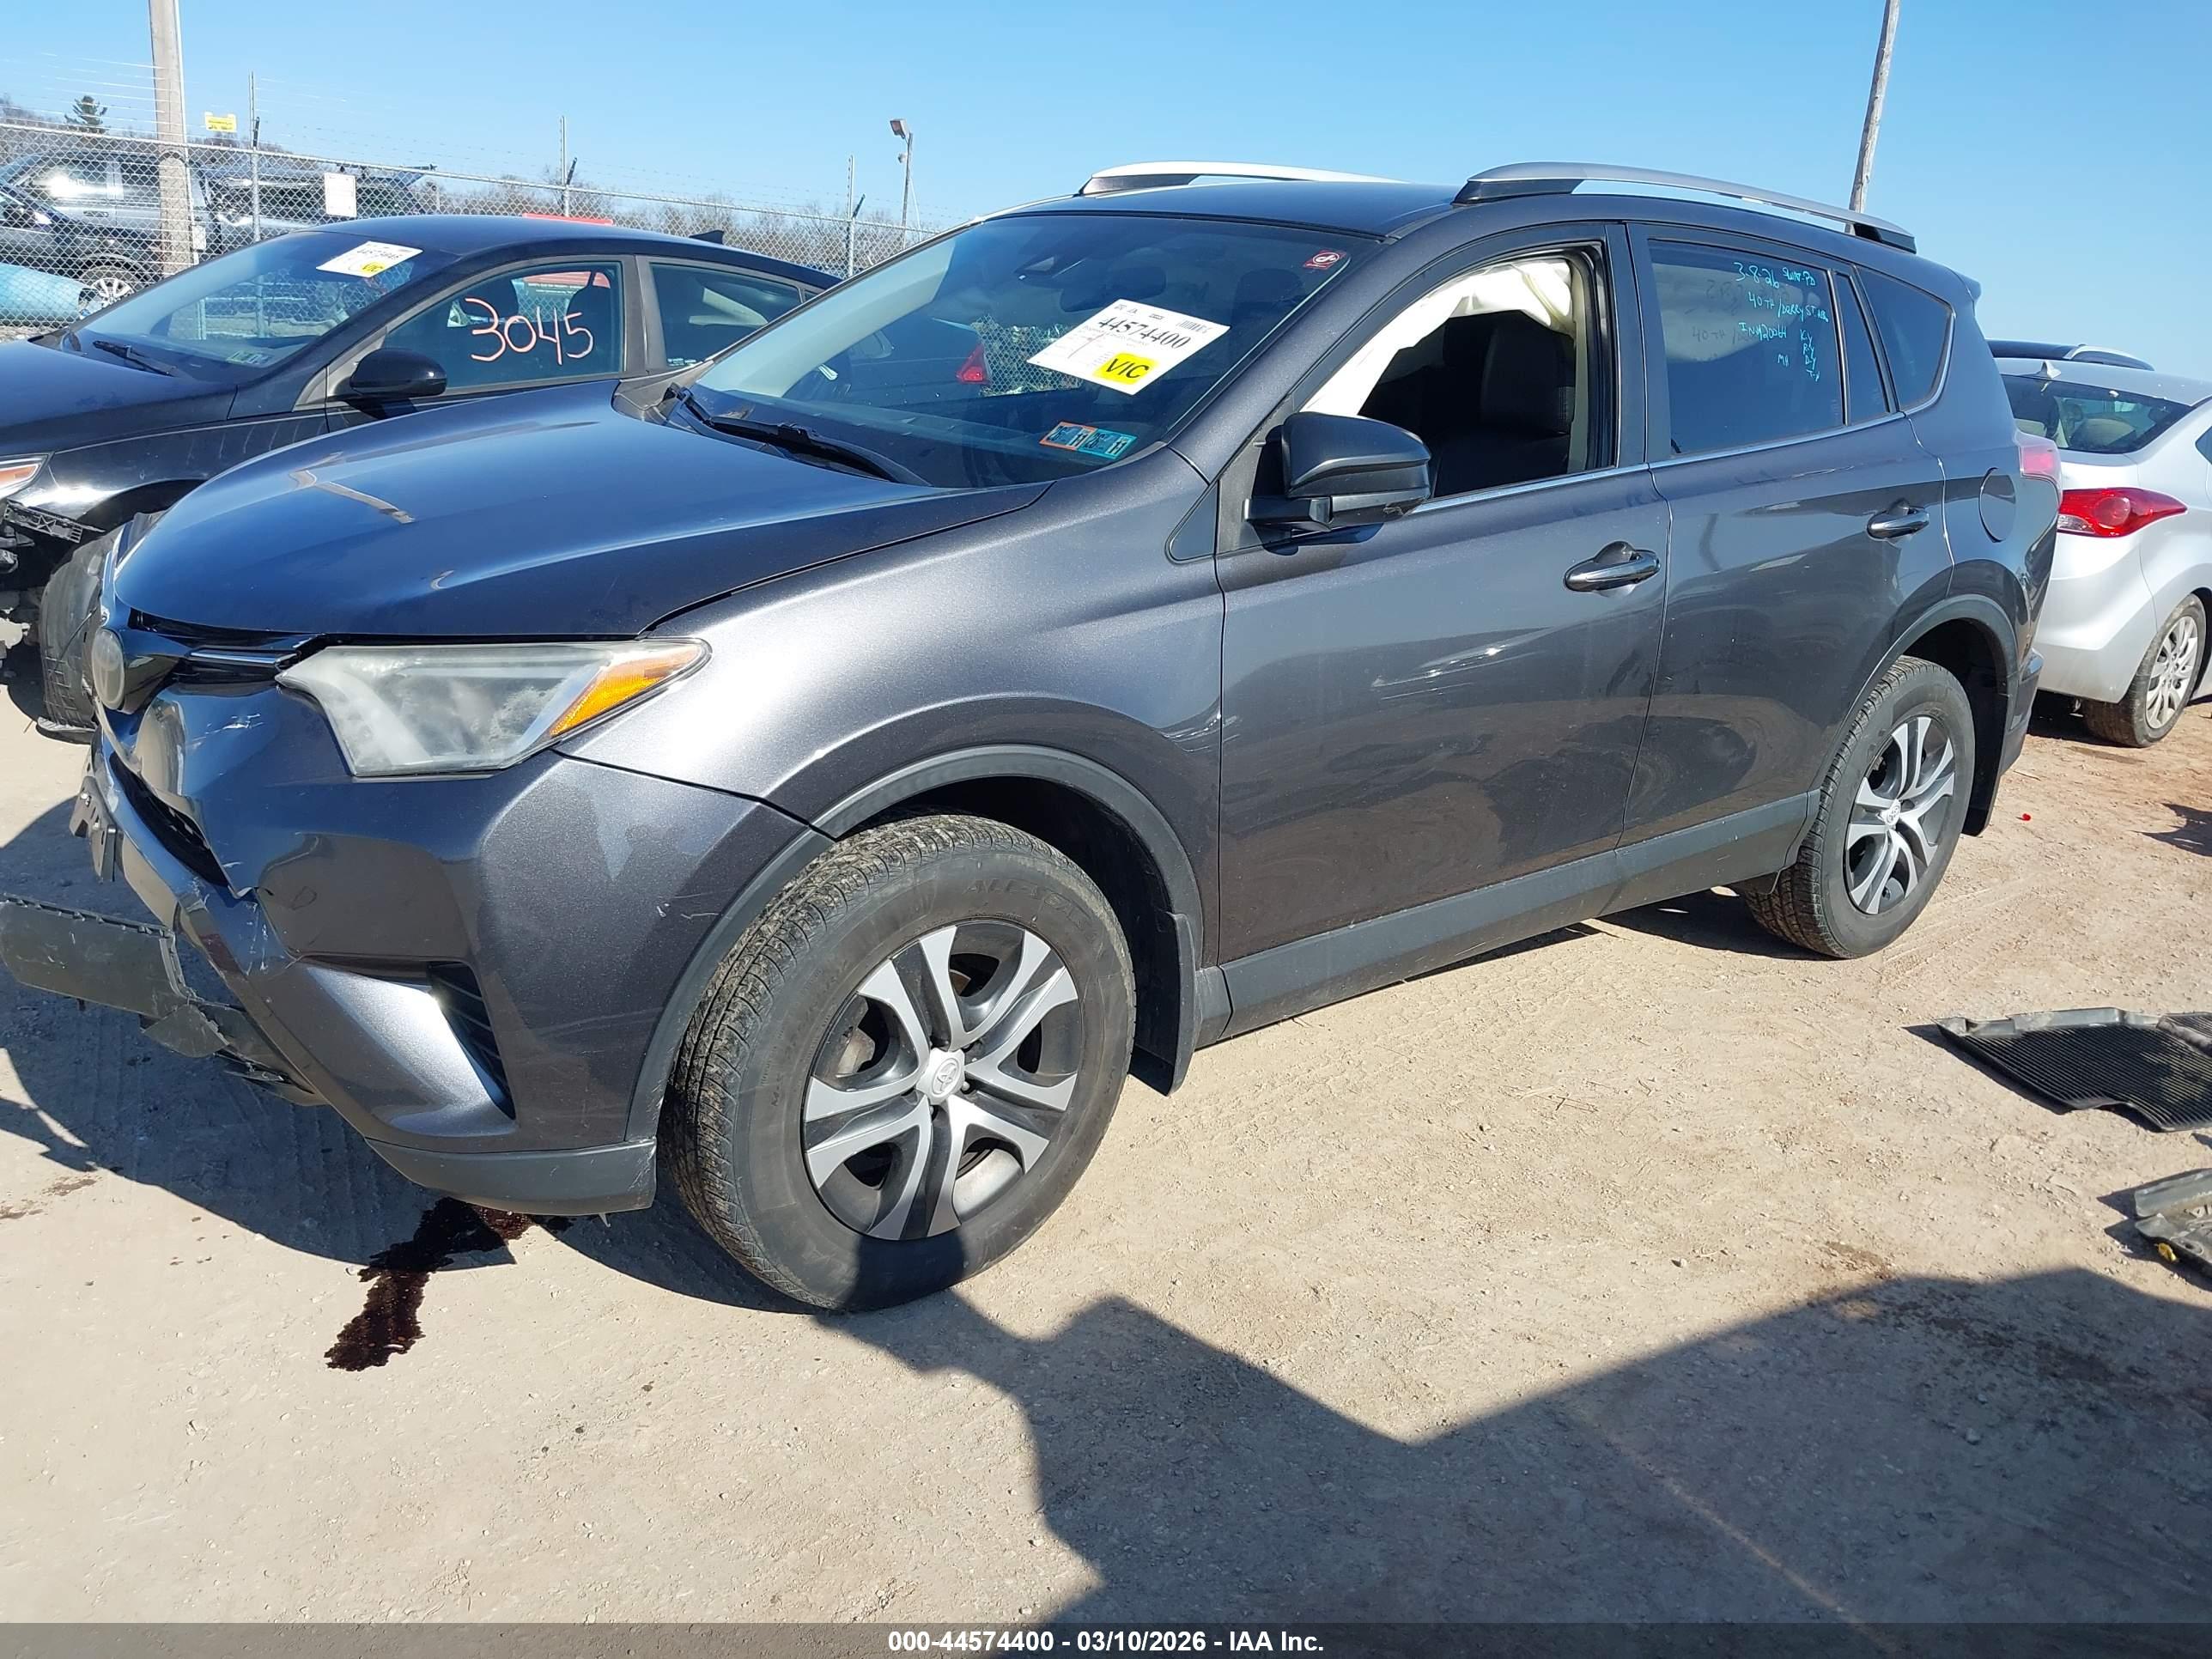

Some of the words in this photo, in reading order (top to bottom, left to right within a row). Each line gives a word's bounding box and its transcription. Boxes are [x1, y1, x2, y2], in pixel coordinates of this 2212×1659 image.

[465, 296, 594, 366] 3045
[1097, 316, 1191, 349] 44574400
[1106, 357, 1150, 379] VIC
